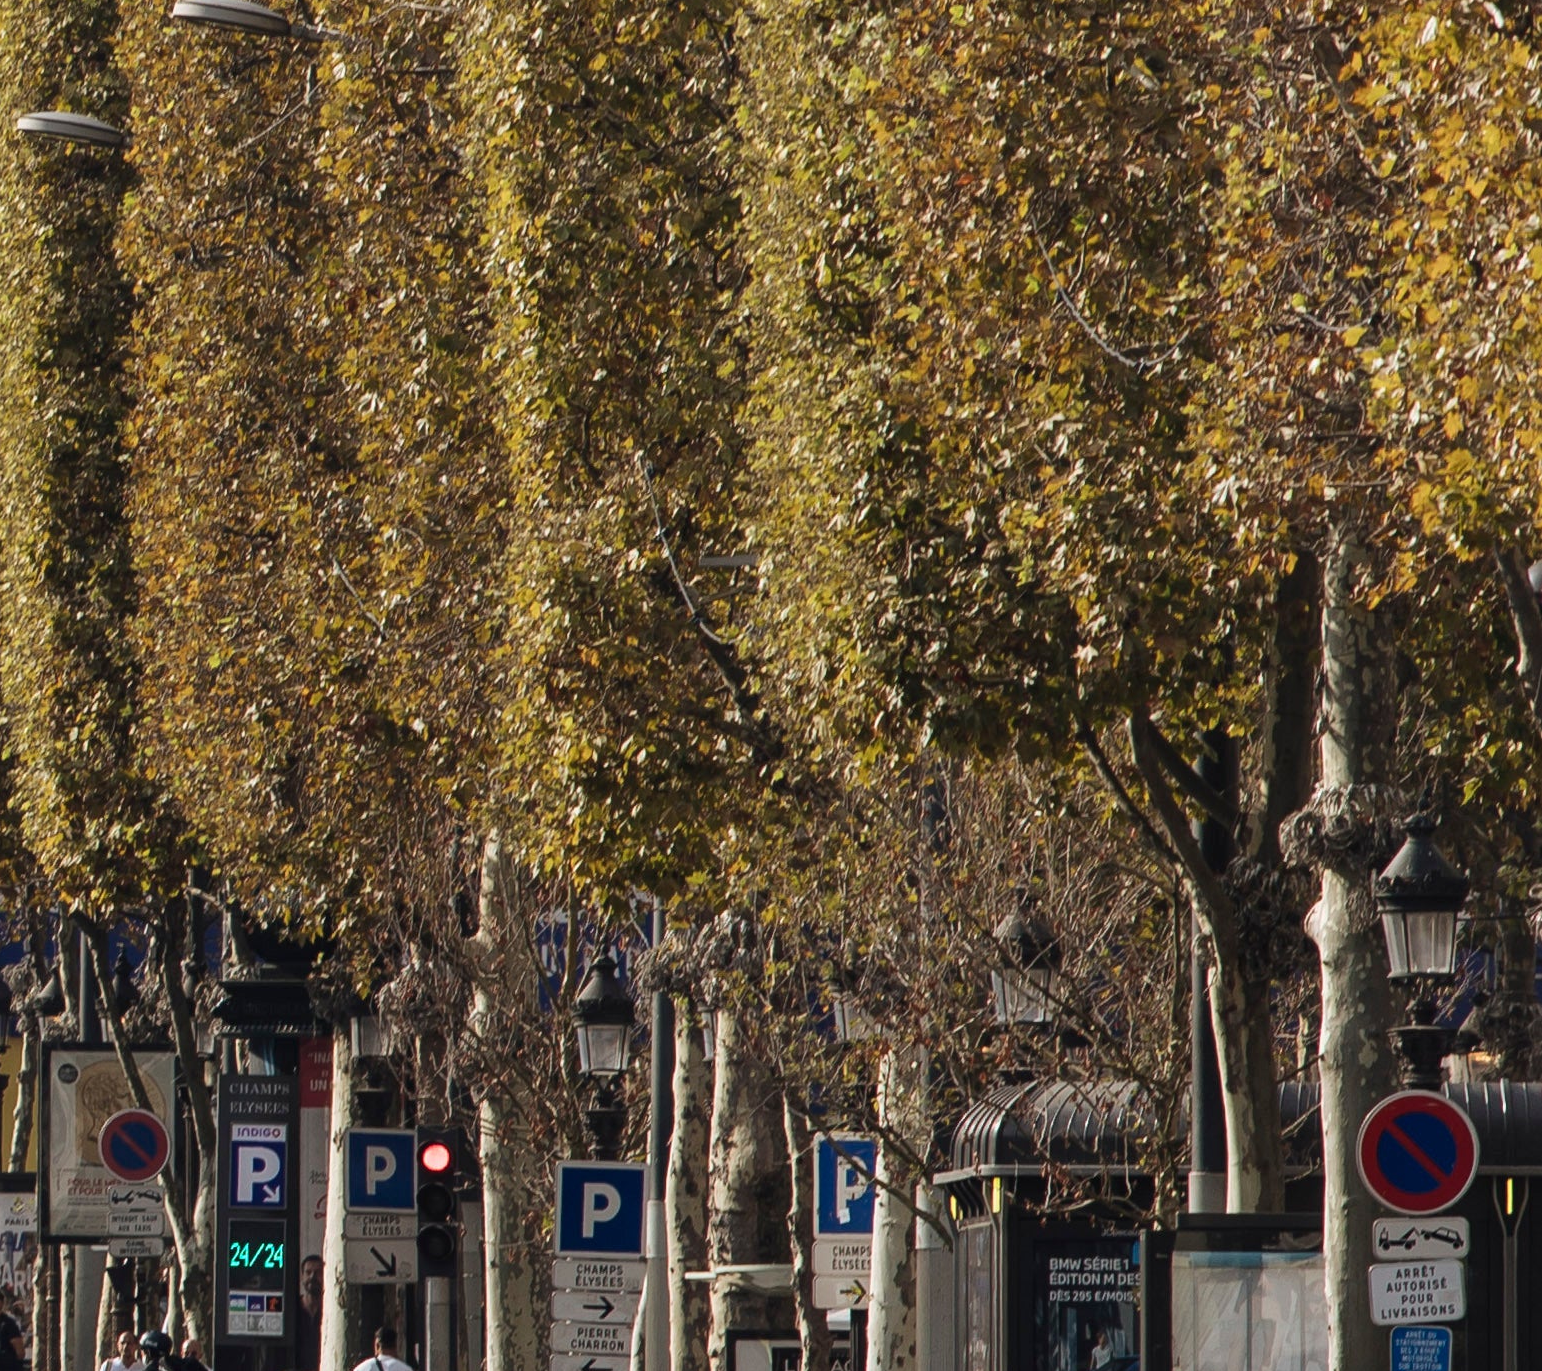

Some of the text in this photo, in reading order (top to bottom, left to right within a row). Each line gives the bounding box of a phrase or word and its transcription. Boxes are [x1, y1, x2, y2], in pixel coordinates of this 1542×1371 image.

[229, 1083, 291, 1095] CHAMPS
[237, 1127, 281, 1138] INDIGO
[237, 1146, 281, 1202] P
[366, 1145, 397, 1196] P
[582, 1182, 622, 1239] P
[5, 1218, 30, 1226] PARIS
[362, 1215, 401, 1225] CHAMPS
[230, 1242, 284, 1268] 24/24
[832, 1245, 871, 1257] CHAMPS
[576, 1263, 623, 1275] CHAMPS
[832, 1257, 871, 1271] ÉLYSÉES
[1049, 1255, 1129, 1271] BMW SÉRIE 1
[1049, 1270, 1101, 1285] ÉDITION
[1103, 1273, 1115, 1285] M
[1396, 1265, 1435, 1279] ARRÊT
[575, 1276, 623, 1288] ÉLYSÉES
[1386, 1278, 1448, 1293] AUTORISÉ
[1072, 1290, 1091, 1301] 295
[1401, 1293, 1434, 1304] POUR
[1381, 1304, 1456, 1320] LIVRAISONS
[577, 1327, 619, 1339] PIERRE
[571, 1338, 625, 1350] CHARRON
